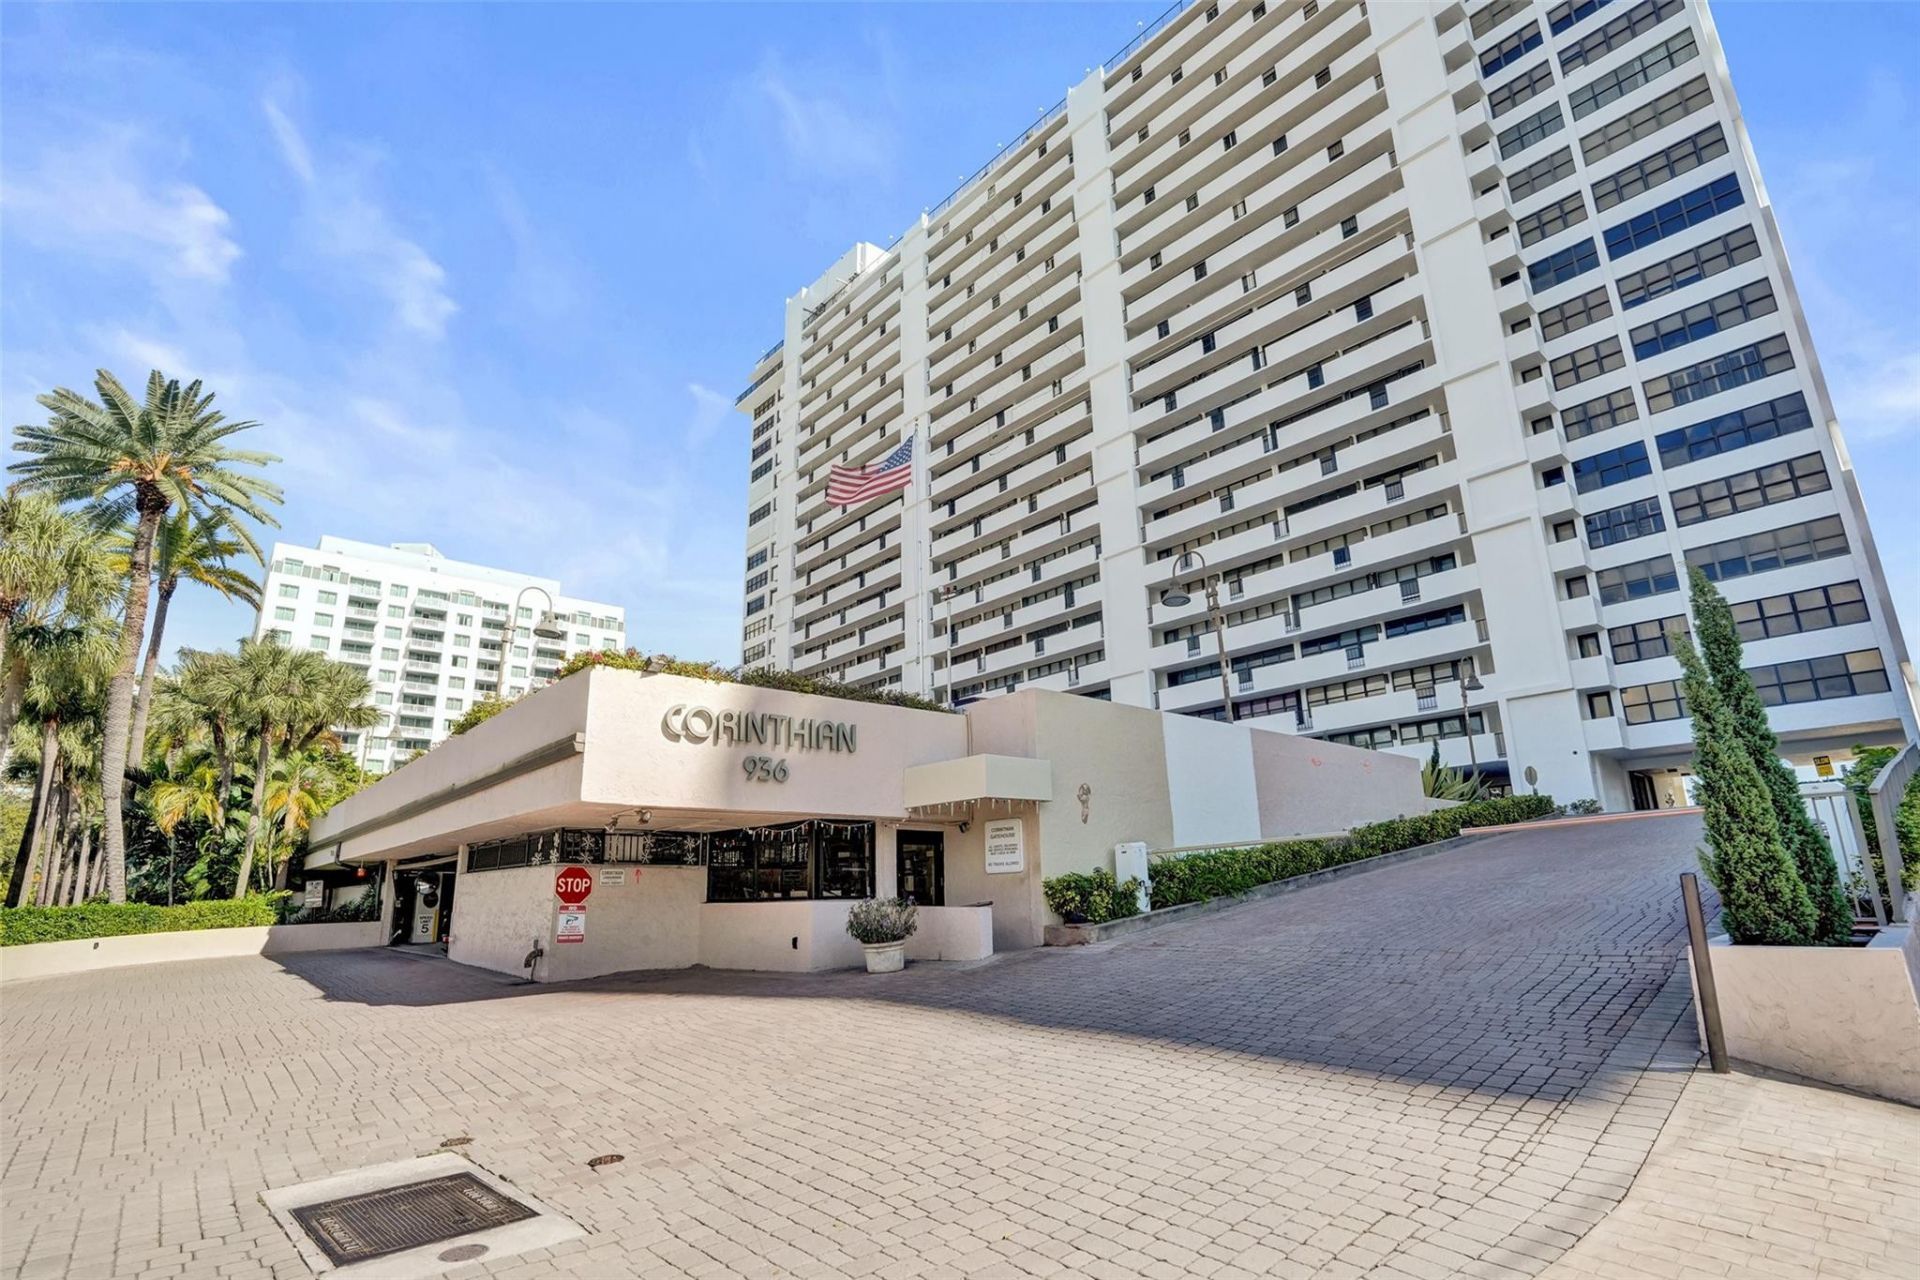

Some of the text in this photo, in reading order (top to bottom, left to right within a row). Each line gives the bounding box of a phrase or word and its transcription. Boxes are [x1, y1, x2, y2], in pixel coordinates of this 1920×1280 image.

[661, 704, 857, 753] CORINTHIAN
[743, 756, 790, 783] 936
[557, 878, 590, 893] STOP
[421, 924, 429, 934] 5
